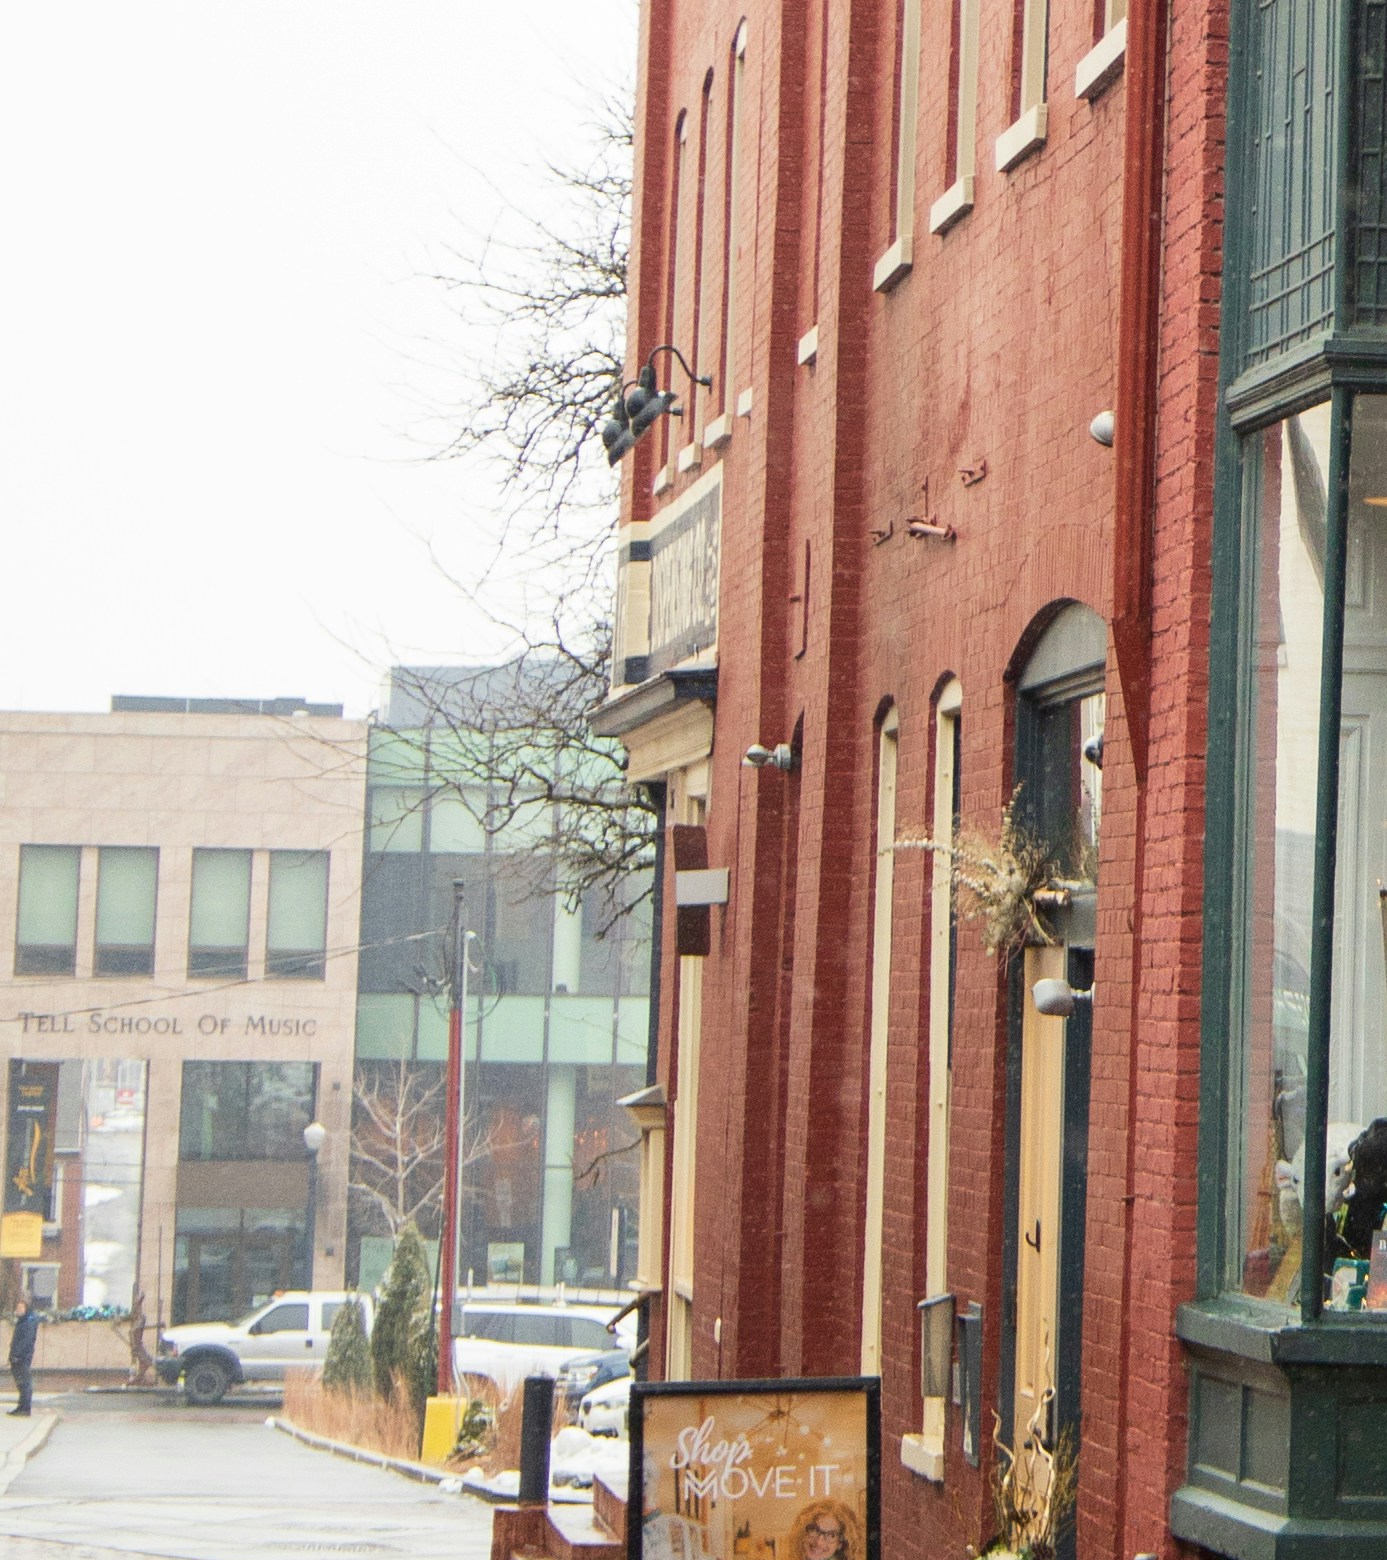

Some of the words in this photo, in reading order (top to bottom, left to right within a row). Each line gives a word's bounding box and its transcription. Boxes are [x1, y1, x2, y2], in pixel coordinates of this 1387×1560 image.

[20, 1012, 75, 1034] TELL
[88, 1013, 184, 1035] SCHOOL
[244, 1014, 318, 1037] MUSIC
[669, 1415, 753, 1479] Shop
[684, 1465, 797, 1501] MOVE
[809, 1464, 840, 1497] IT
